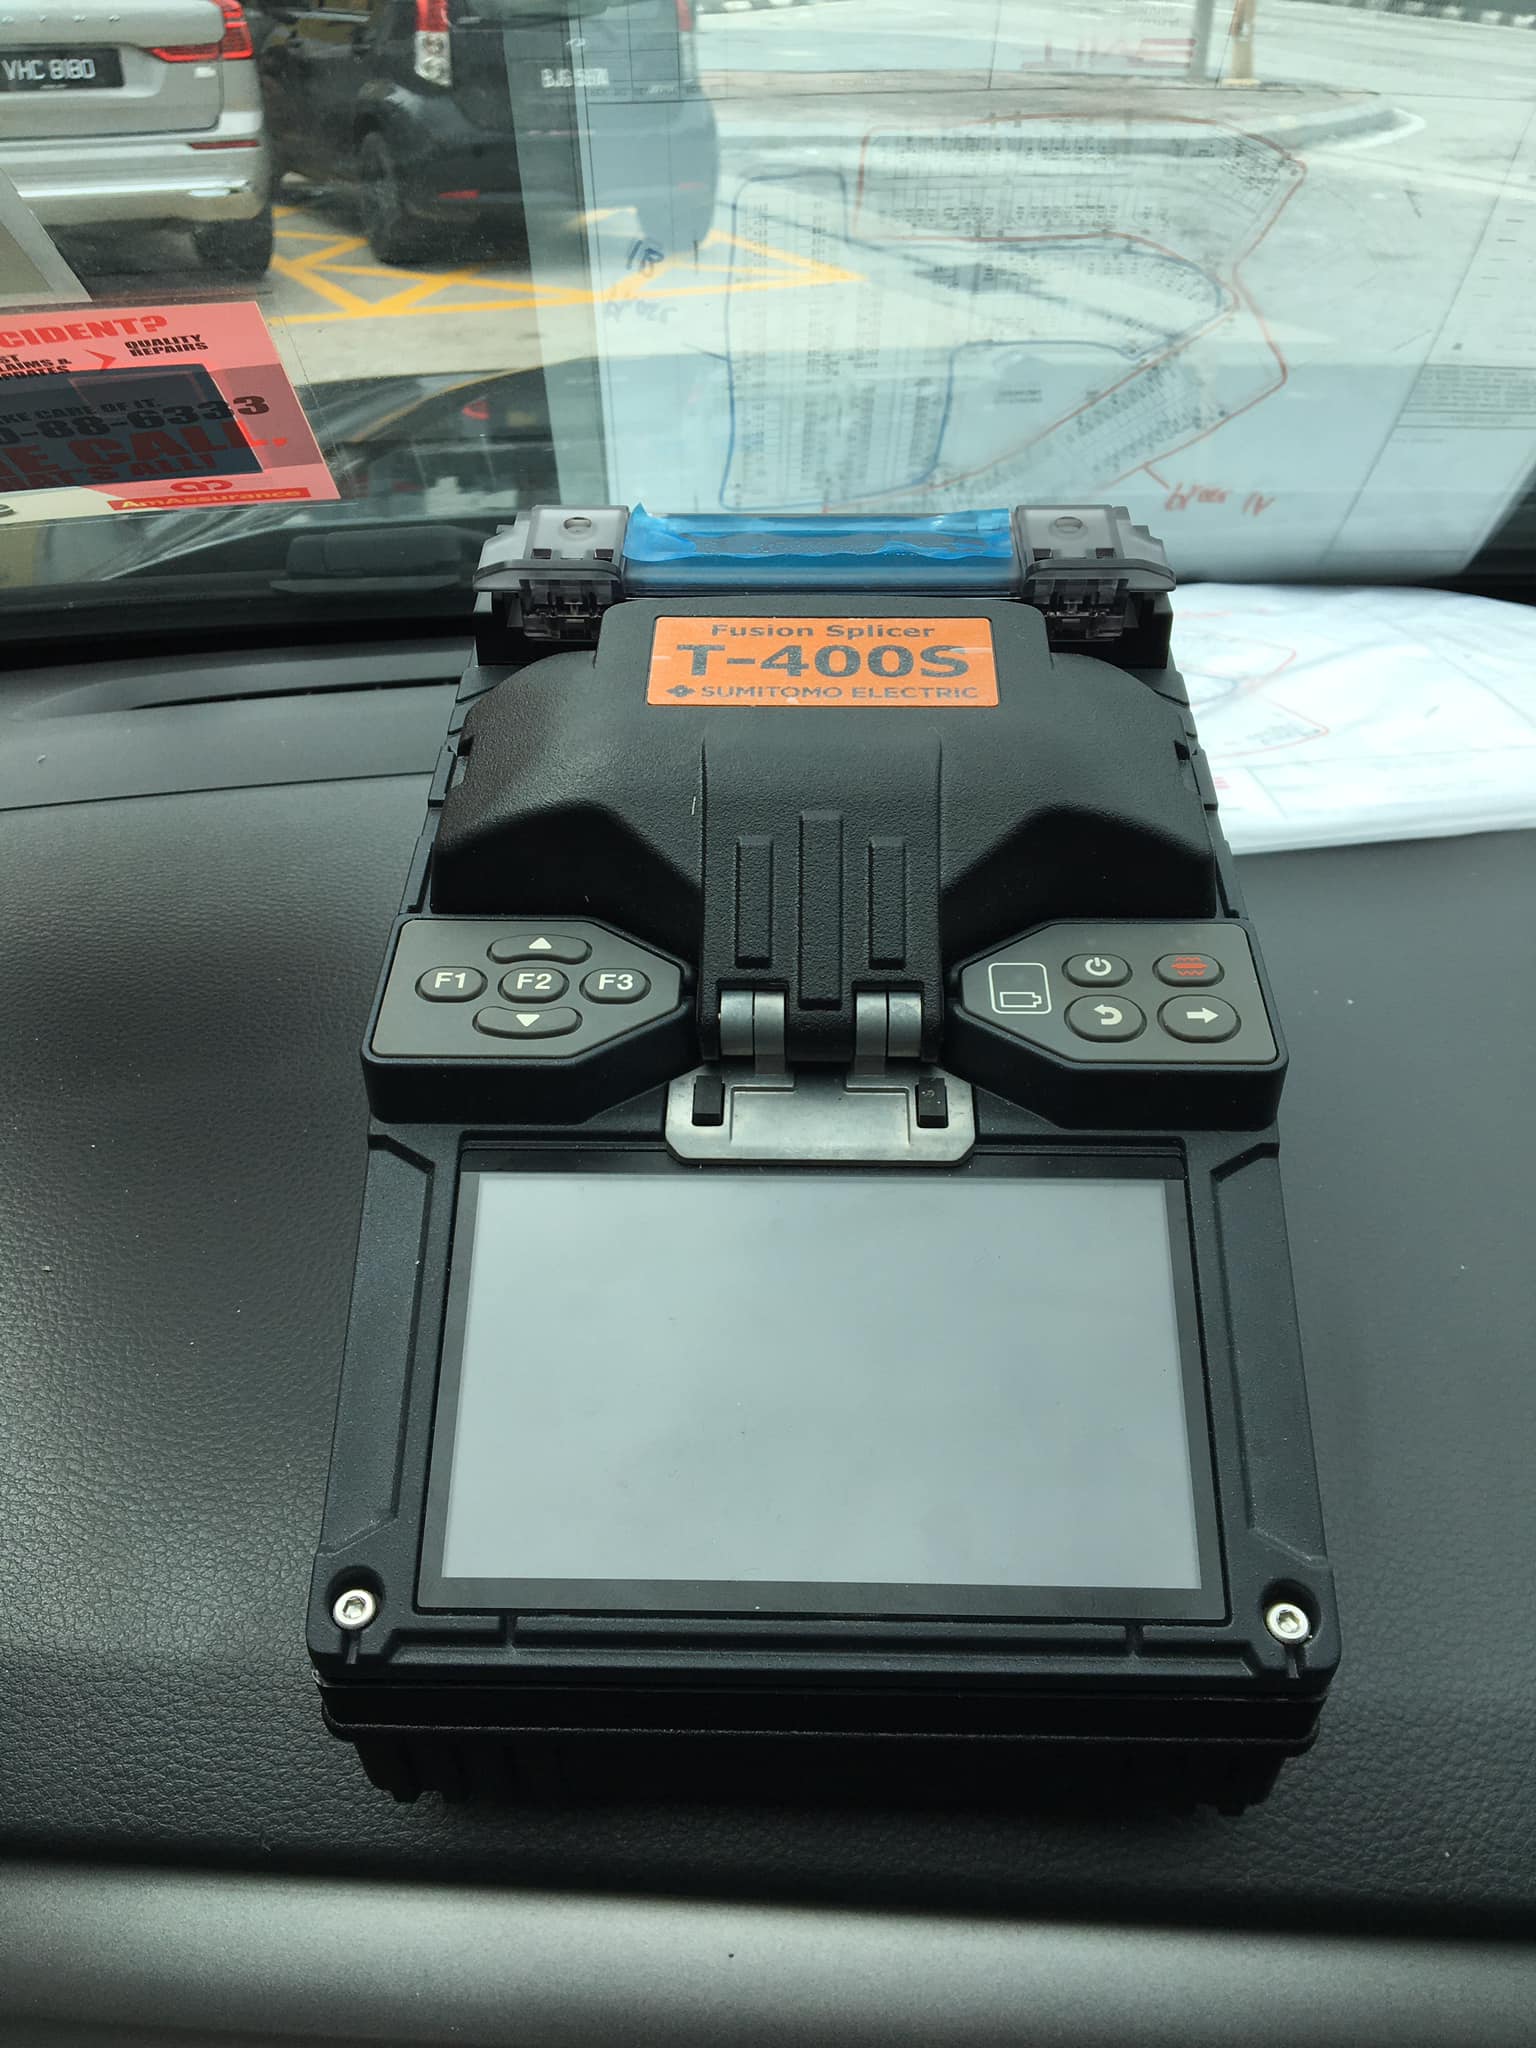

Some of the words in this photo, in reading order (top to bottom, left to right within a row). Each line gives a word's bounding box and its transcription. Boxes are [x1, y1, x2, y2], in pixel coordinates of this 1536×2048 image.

[1, 59, 46, 81] VHC
[50, 58, 97, 80] 8180
[124, 334, 201, 350] QUALITY
[129, 343, 209, 357] REPAIRS
[121, 488, 301, 509] AmAssurance
[711, 624, 810, 638] Fusion
[826, 624, 936, 641] Splicer
[676, 644, 970, 679] T-400S
[701, 685, 842, 699] SUMITOMO
[851, 686, 979, 699] ELECTRIC
[434, 972, 467, 989] F1
[516, 973, 553, 990] F2
[598, 974, 634, 991] F3
